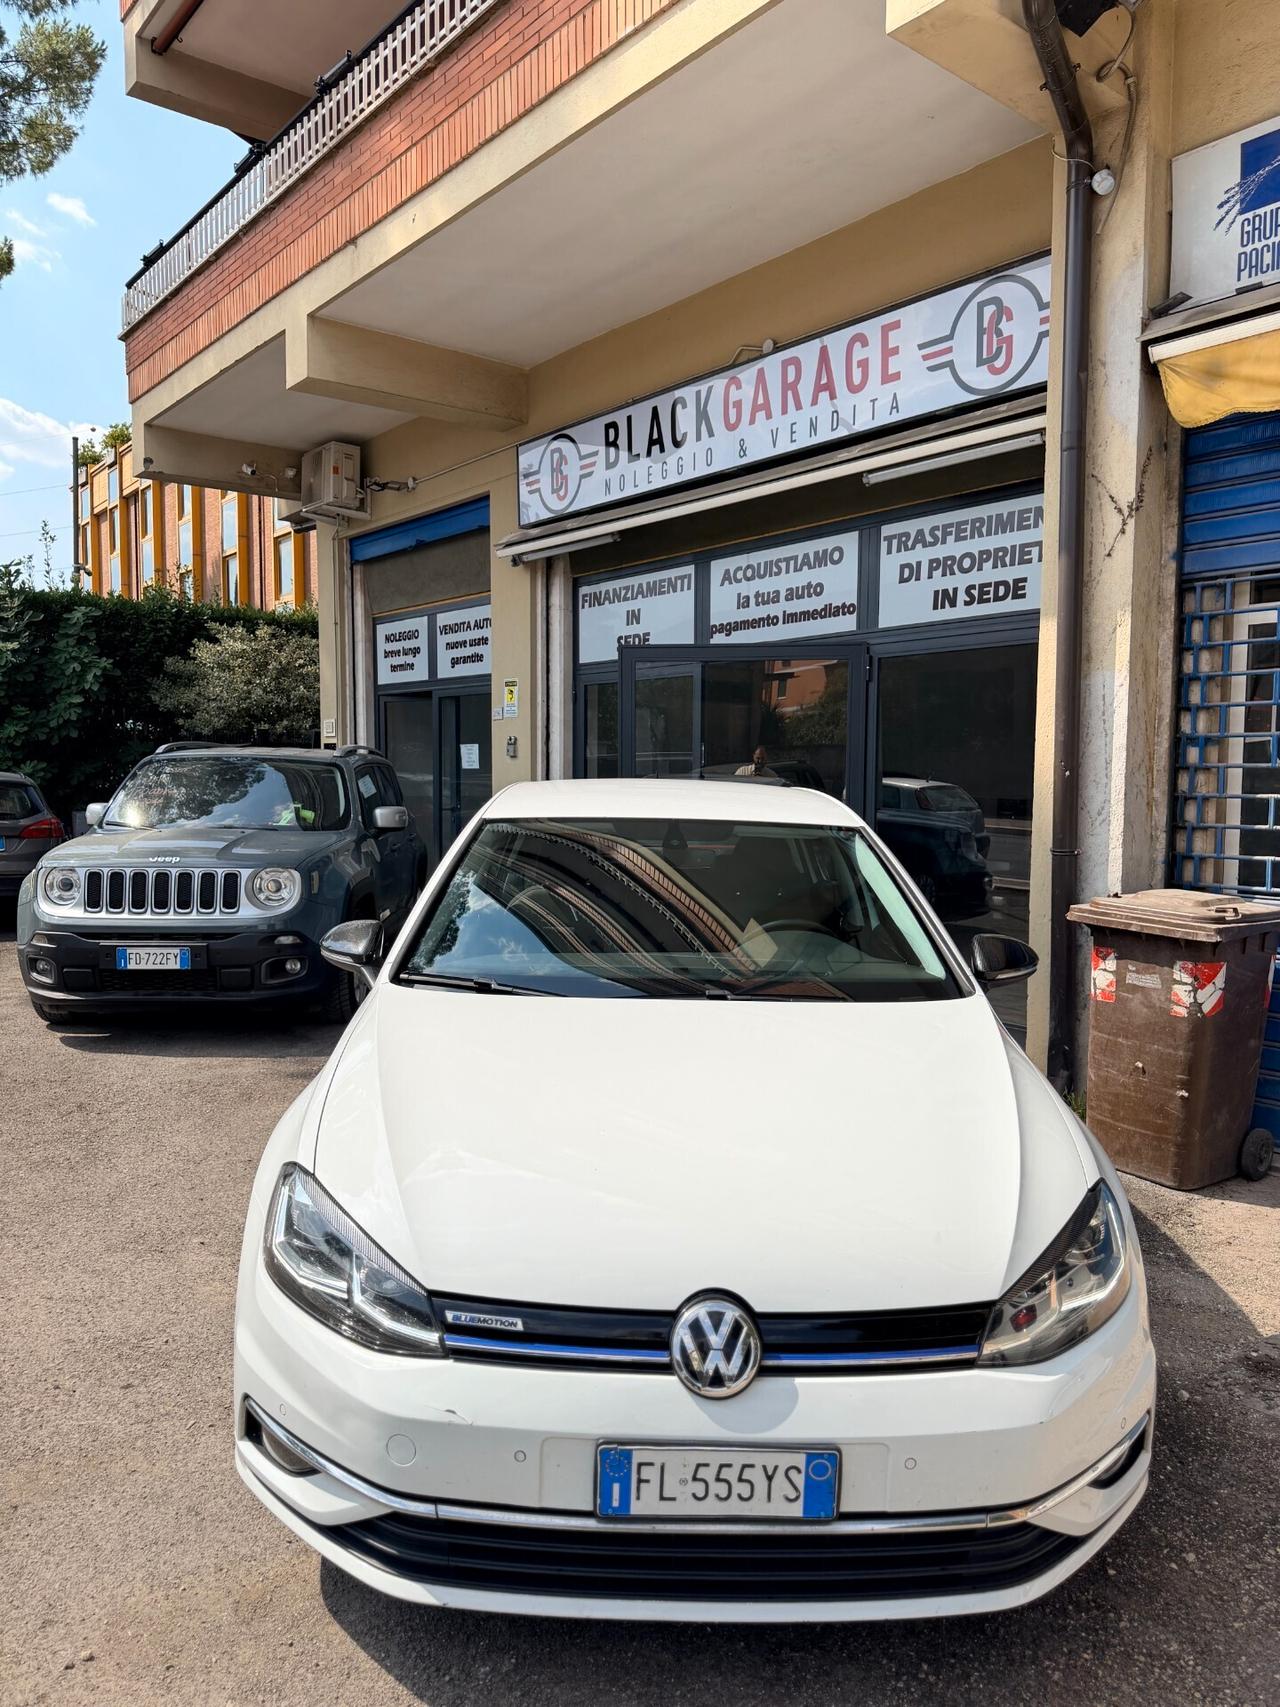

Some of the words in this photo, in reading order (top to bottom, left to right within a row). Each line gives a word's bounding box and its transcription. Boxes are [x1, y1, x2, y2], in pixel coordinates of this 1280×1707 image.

[604, 448, 713, 497] NOLEGGIO
[738, 438, 748, 459] &
[771, 392, 900, 449] VENDITA
[719, 545, 845, 587] ACQUISTIAMO
[898, 560, 922, 584] DI
[581, 573, 692, 609] FINANZIAMENTI
[736, 592, 750, 610] la
[754, 589, 781, 607] tua
[784, 580, 825, 602] auto
[932, 587, 958, 611] IN
[963, 577, 1028, 607] SEDE
[626, 608, 641, 626] IN
[710, 614, 779, 639] pagamento
[782, 602, 857, 625] immediato
[385, 629, 419, 644] NOLEGGIO
[439, 621, 472, 636] VENDITA
[446, 639, 467, 651] nuove
[469, 635, 489, 648] usate
[384, 649, 401, 659] breve
[402, 646, 421, 658] lungo
[451, 652, 484, 669] garantite
[390, 660, 415, 673] termine
[149, 856, 181, 864] Jeep
[451, 1314, 518, 1328] BLUEMOTION
